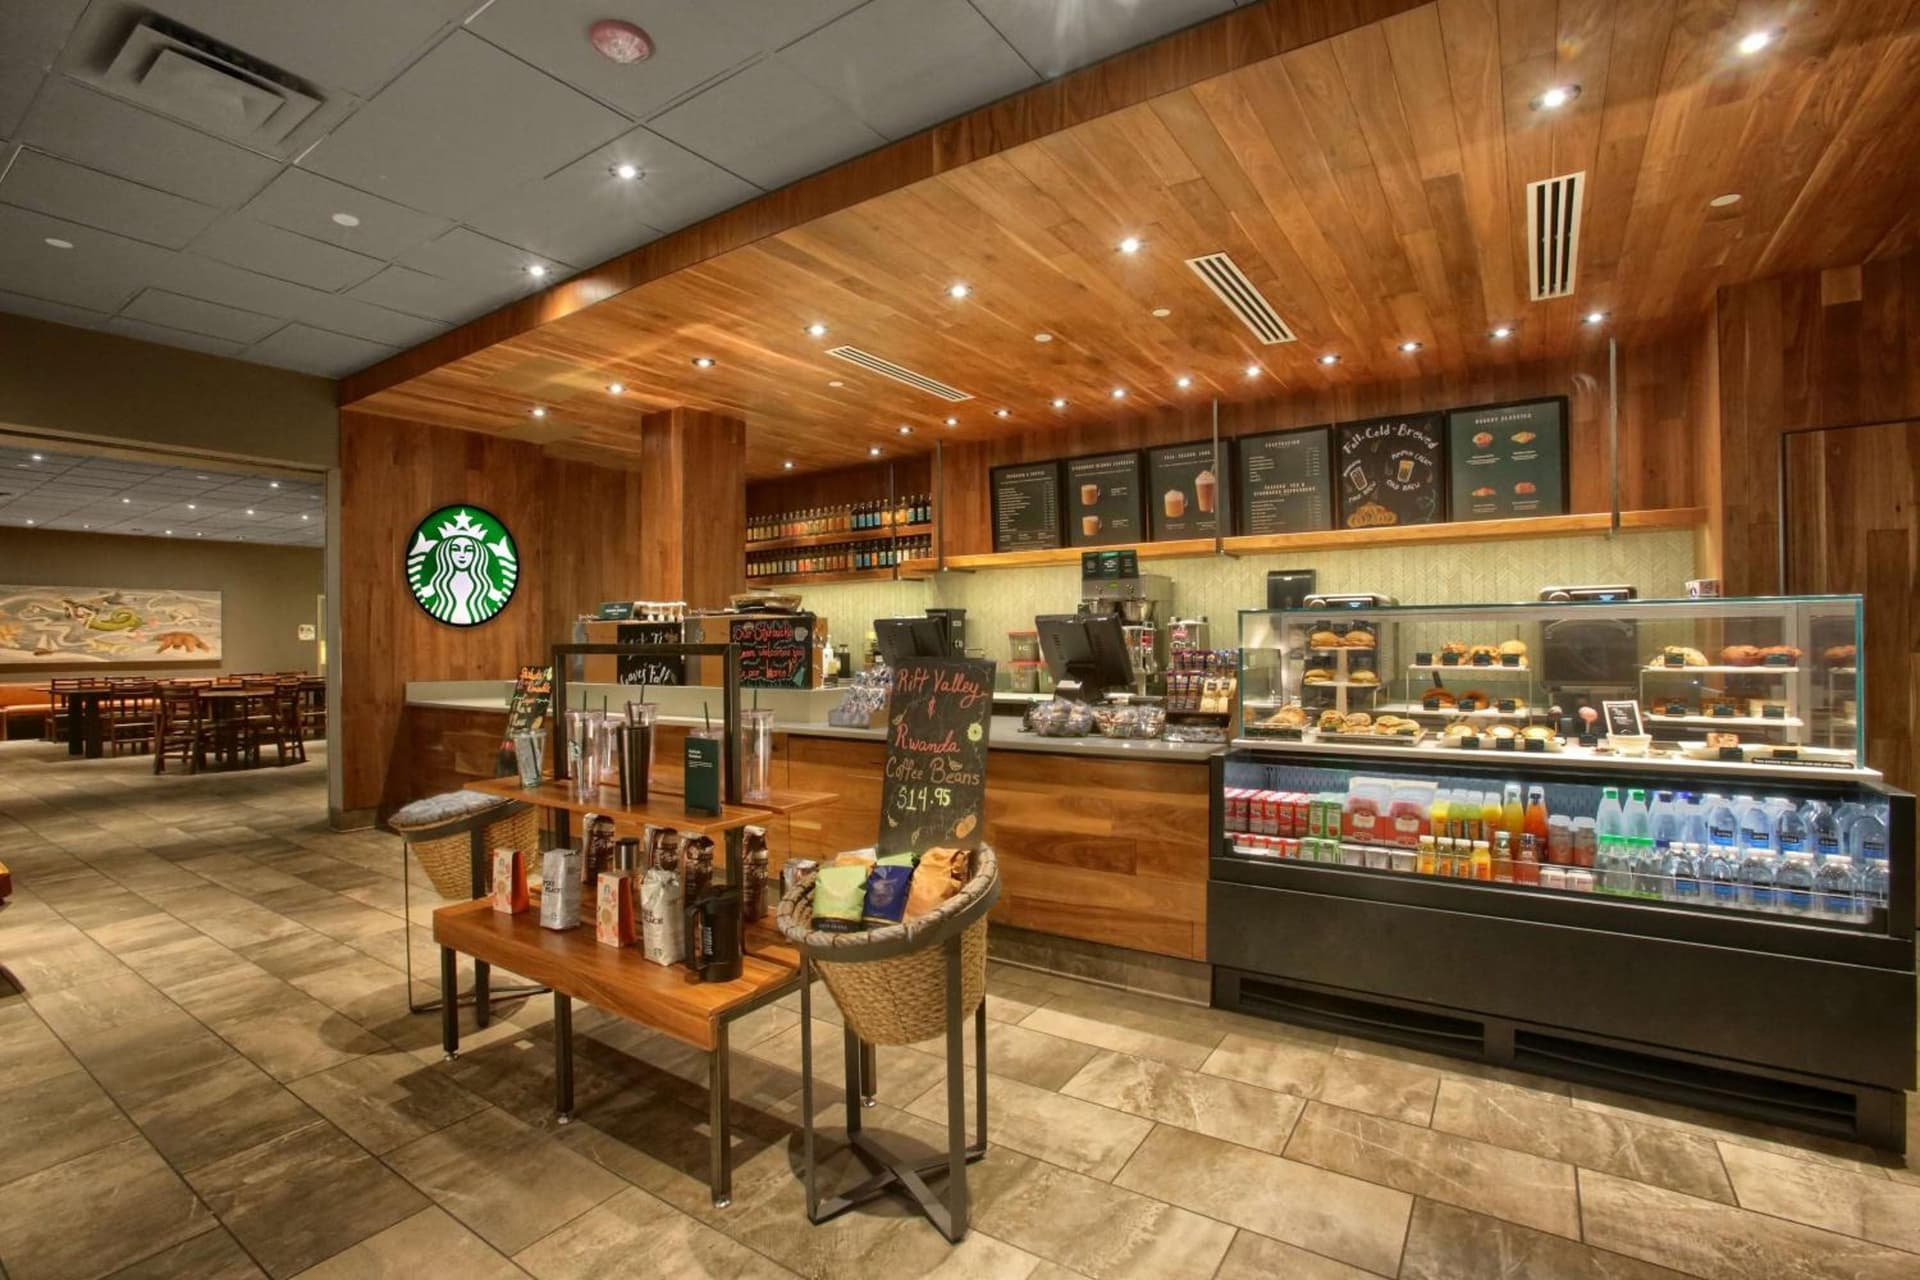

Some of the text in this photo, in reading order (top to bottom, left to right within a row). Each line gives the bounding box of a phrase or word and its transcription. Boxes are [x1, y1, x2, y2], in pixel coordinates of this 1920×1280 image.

[898, 667, 988, 709] Rift Valley
[895, 723, 960, 753] Rwanda
[886, 755, 980, 785] Coffee Beans
[897, 786, 952, 812] $14.95
